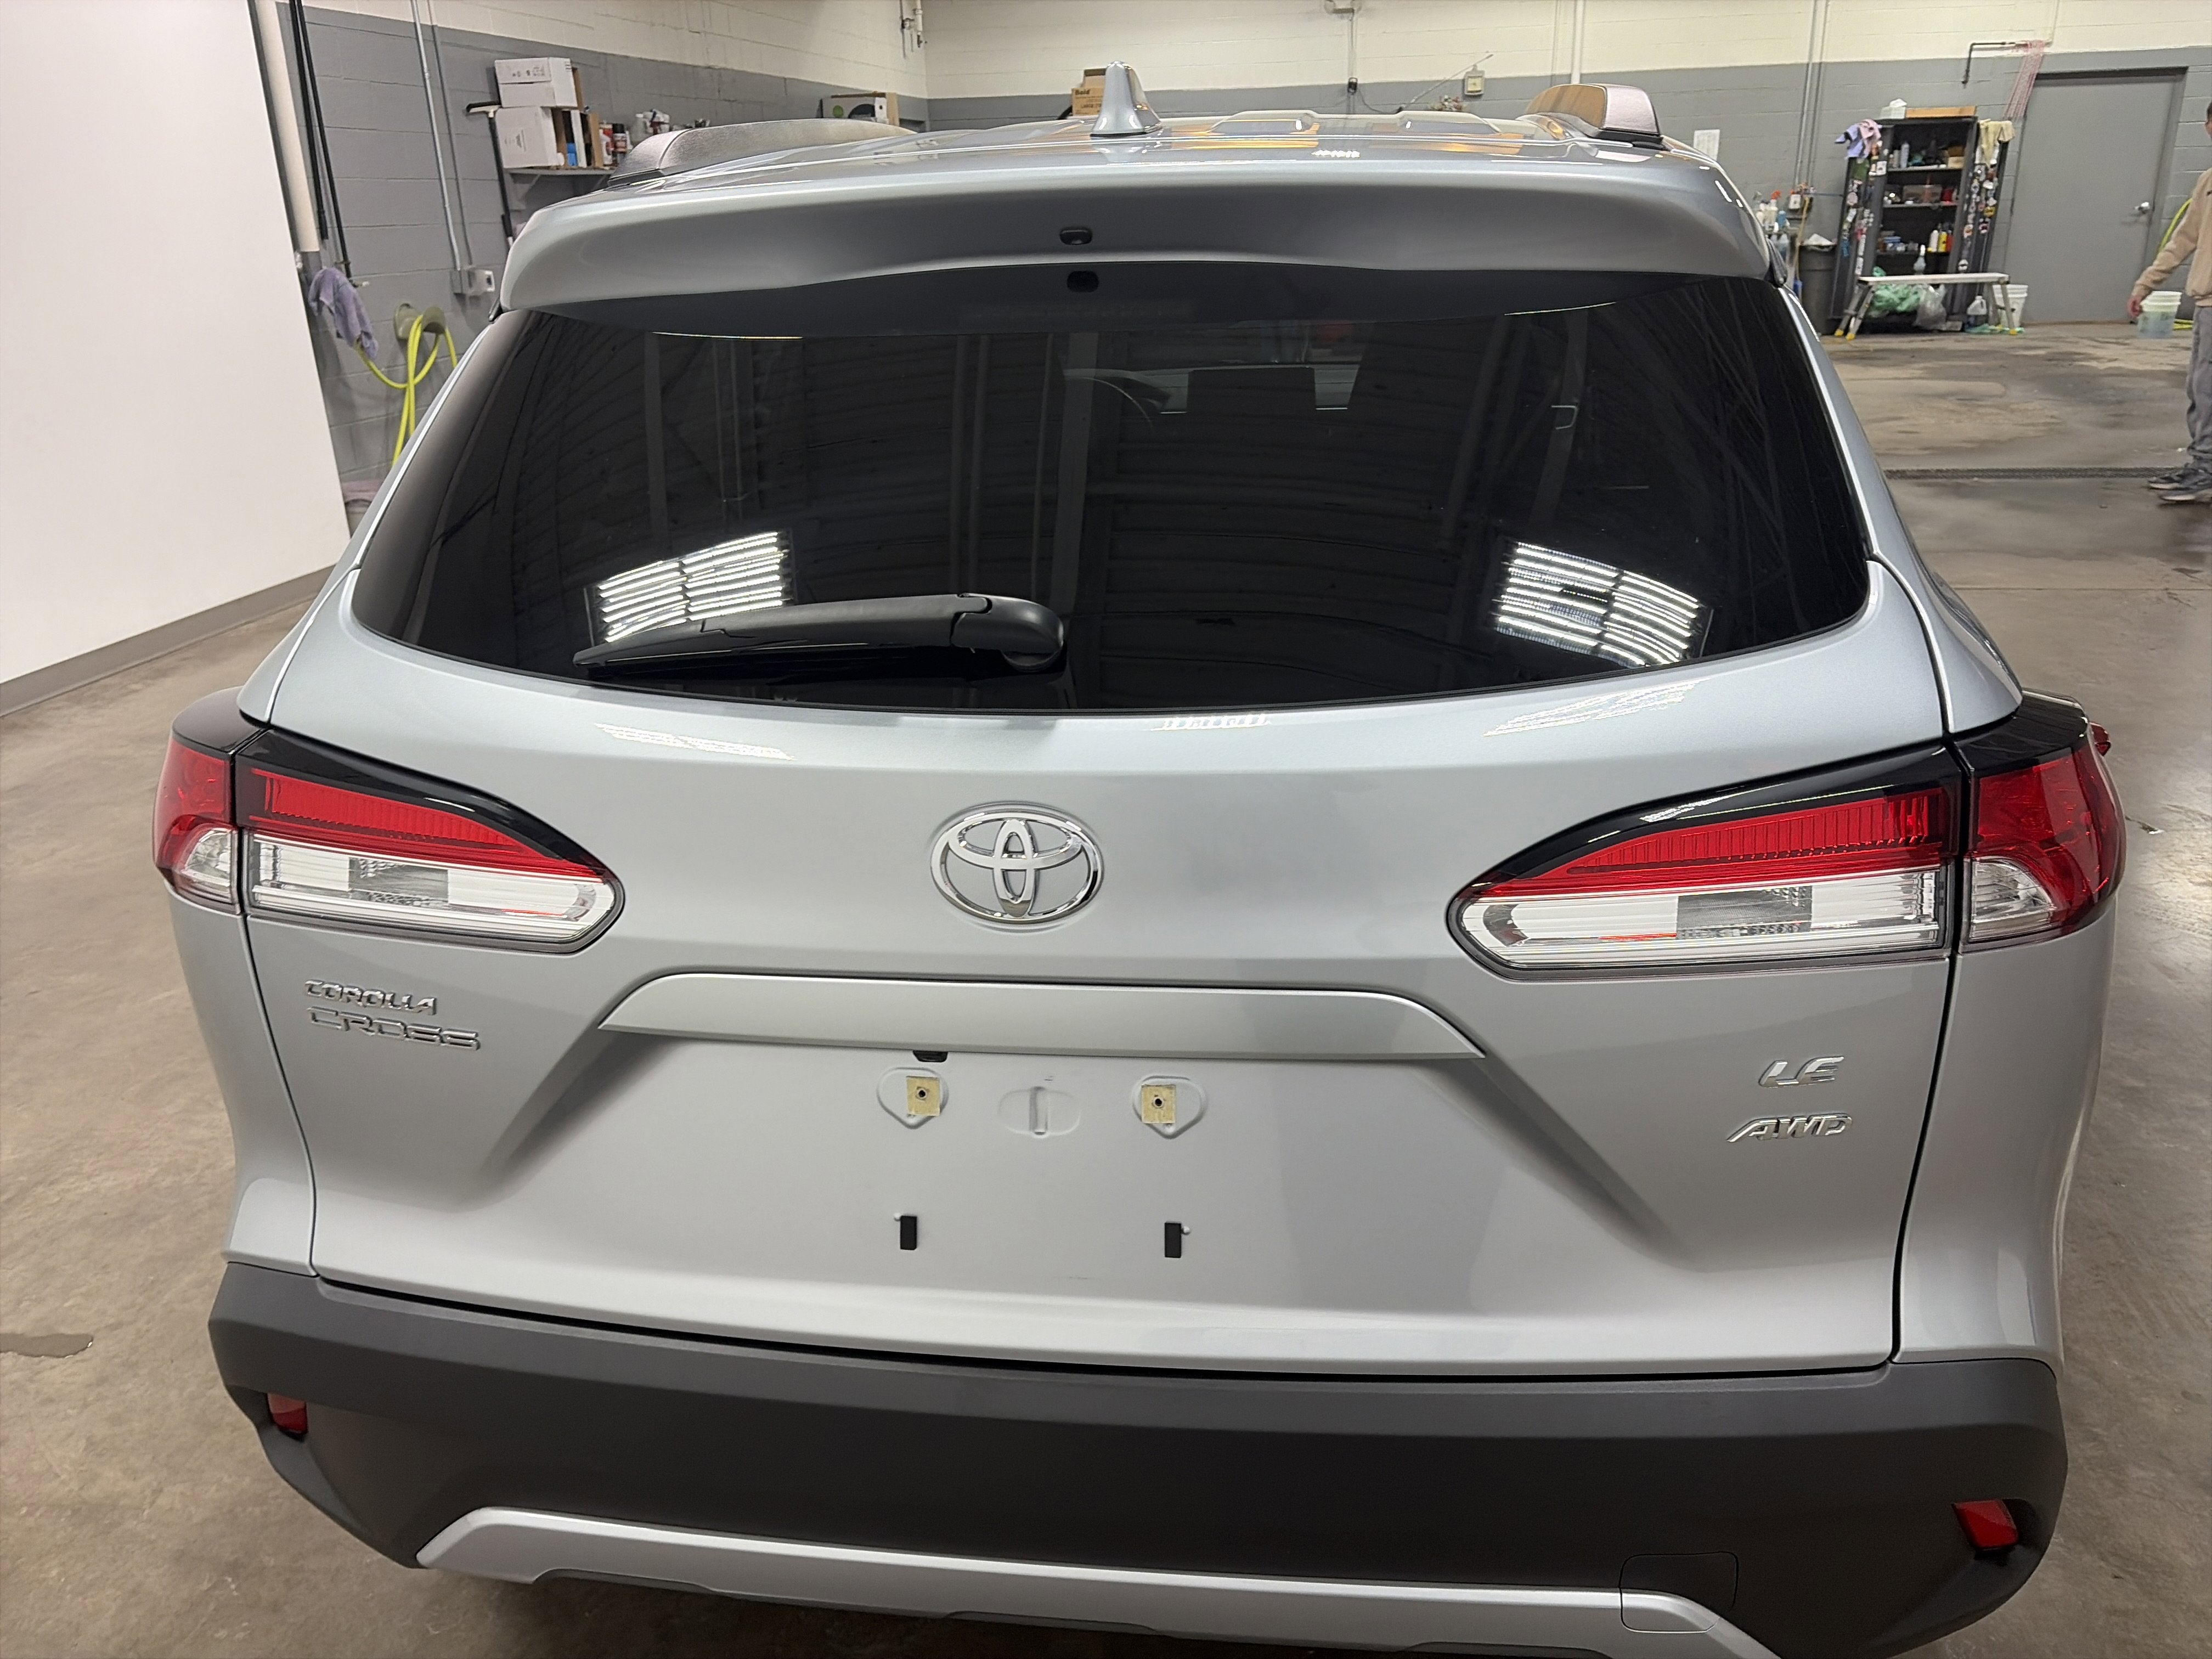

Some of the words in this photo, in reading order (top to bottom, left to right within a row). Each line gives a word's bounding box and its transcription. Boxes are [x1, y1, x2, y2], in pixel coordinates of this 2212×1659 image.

[305, 979, 437, 1015] COROLLA
[307, 1006, 481, 1051] CROSS
[1758, 1056, 1844, 1088] LE
[1726, 1113, 1852, 1142] AWD
